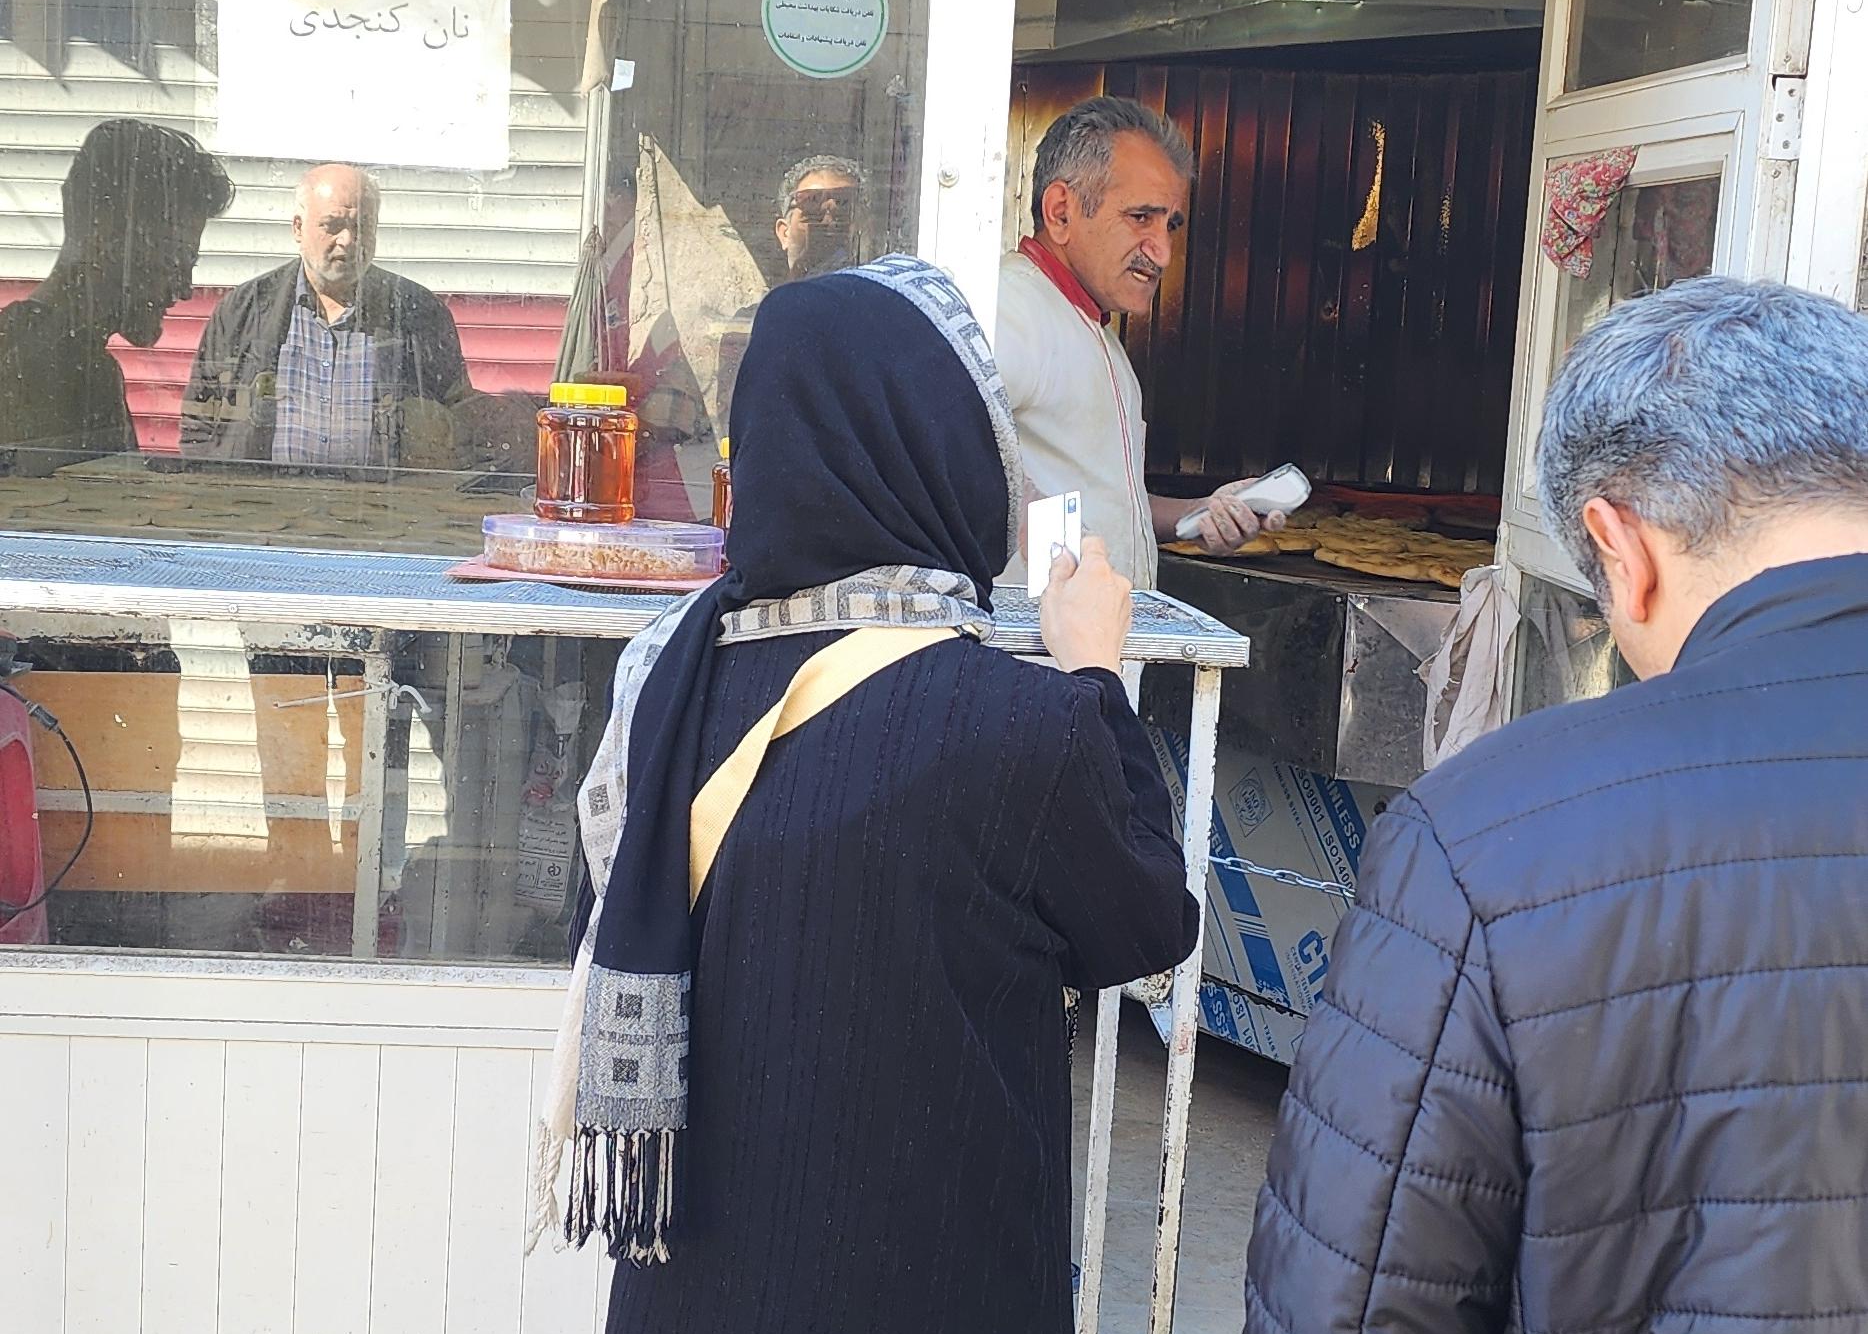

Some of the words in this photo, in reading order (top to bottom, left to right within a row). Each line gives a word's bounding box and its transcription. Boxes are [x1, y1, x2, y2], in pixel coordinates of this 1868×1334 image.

[289, 3, 409, 39] کنجدی
[423, 6, 469, 49] نان
[1249, 789, 1260, 809] ISO
[1322, 773, 1361, 849] AINLESS
[1322, 830, 1354, 889] ISO1400
